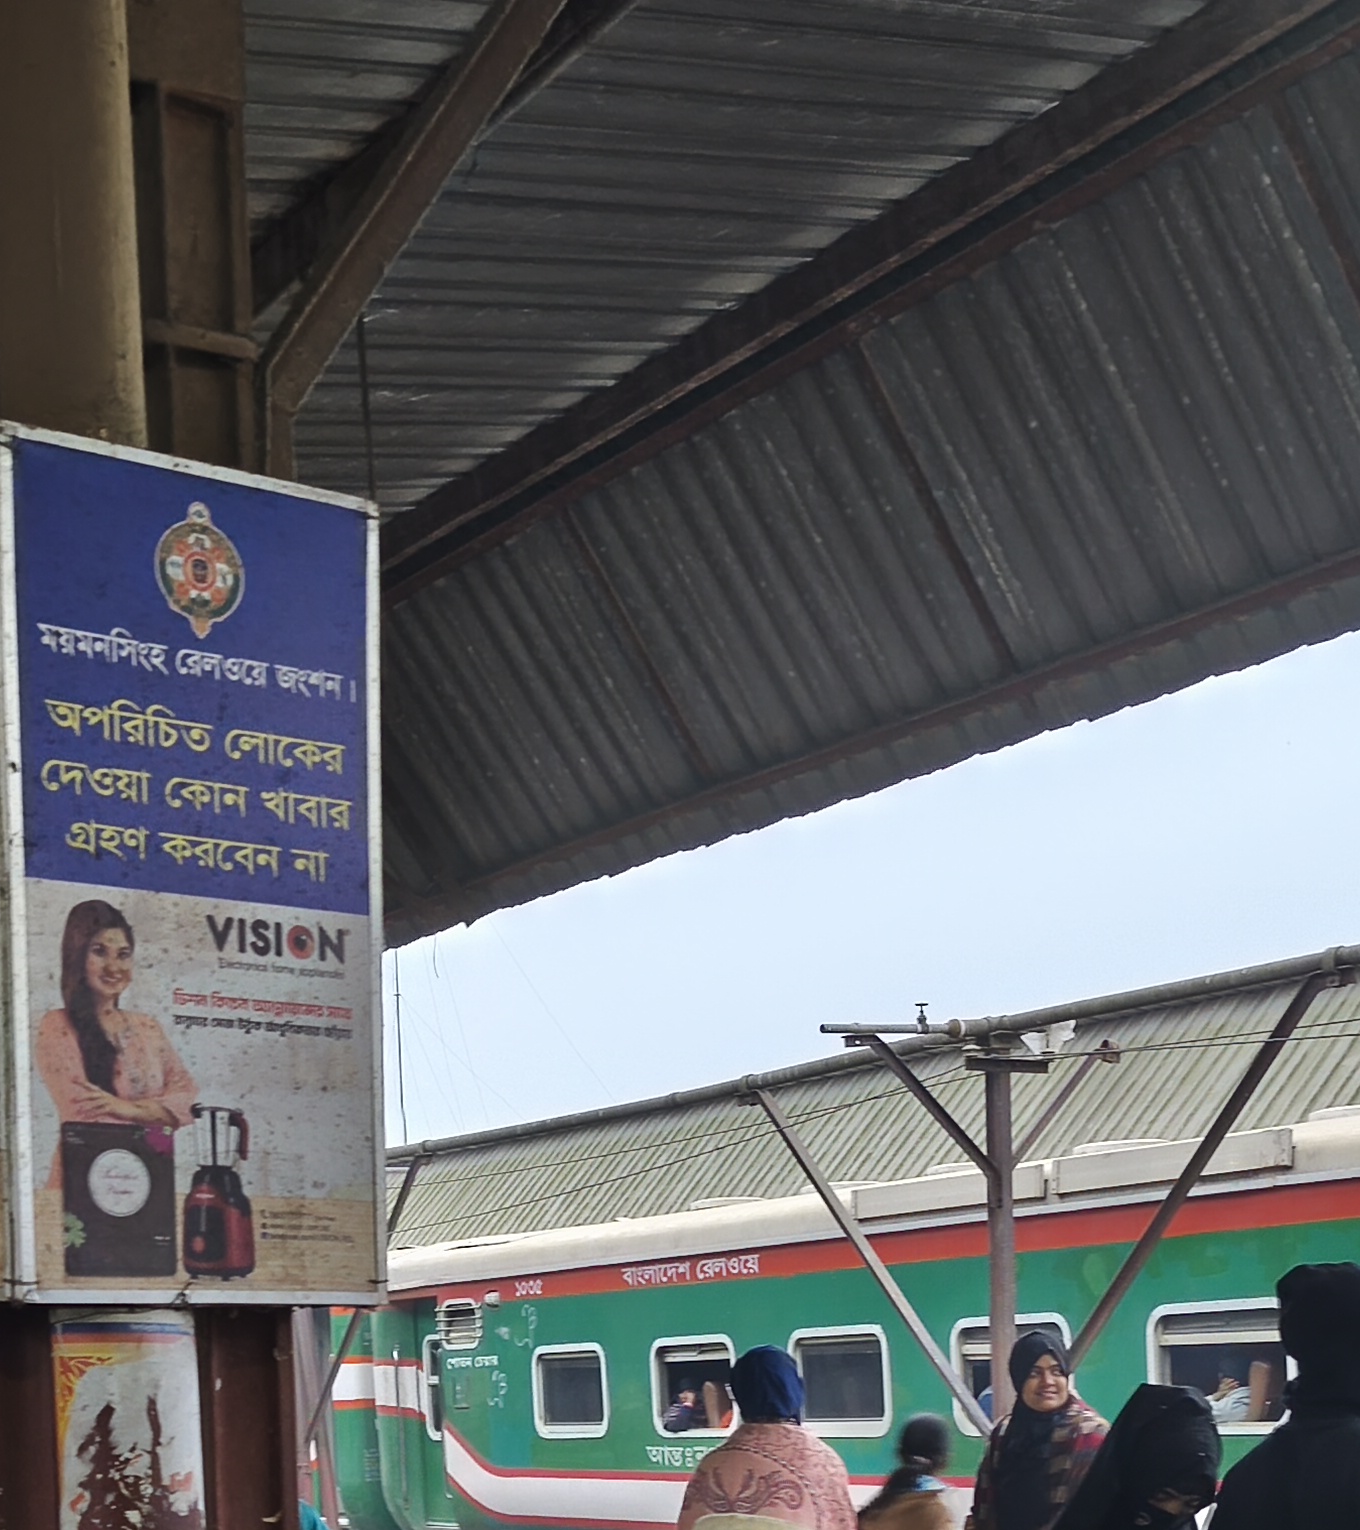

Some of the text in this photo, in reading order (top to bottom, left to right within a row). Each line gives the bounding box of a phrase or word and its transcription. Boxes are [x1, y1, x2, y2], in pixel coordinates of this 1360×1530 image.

[36, 622, 169, 675] ময়মনসিংহ
[175, 648, 270, 688] রেলওয়ে
[44, 699, 346, 775] অপরিচিত লোকের
[41, 759, 353, 831] দেওয়া কোন খাবার
[65, 819, 331, 883] গ্রহণ করবেন না
[206, 914, 346, 965] VISION
[621, 1254, 761, 1288] বাংলাদেশ রেলওয়ে
